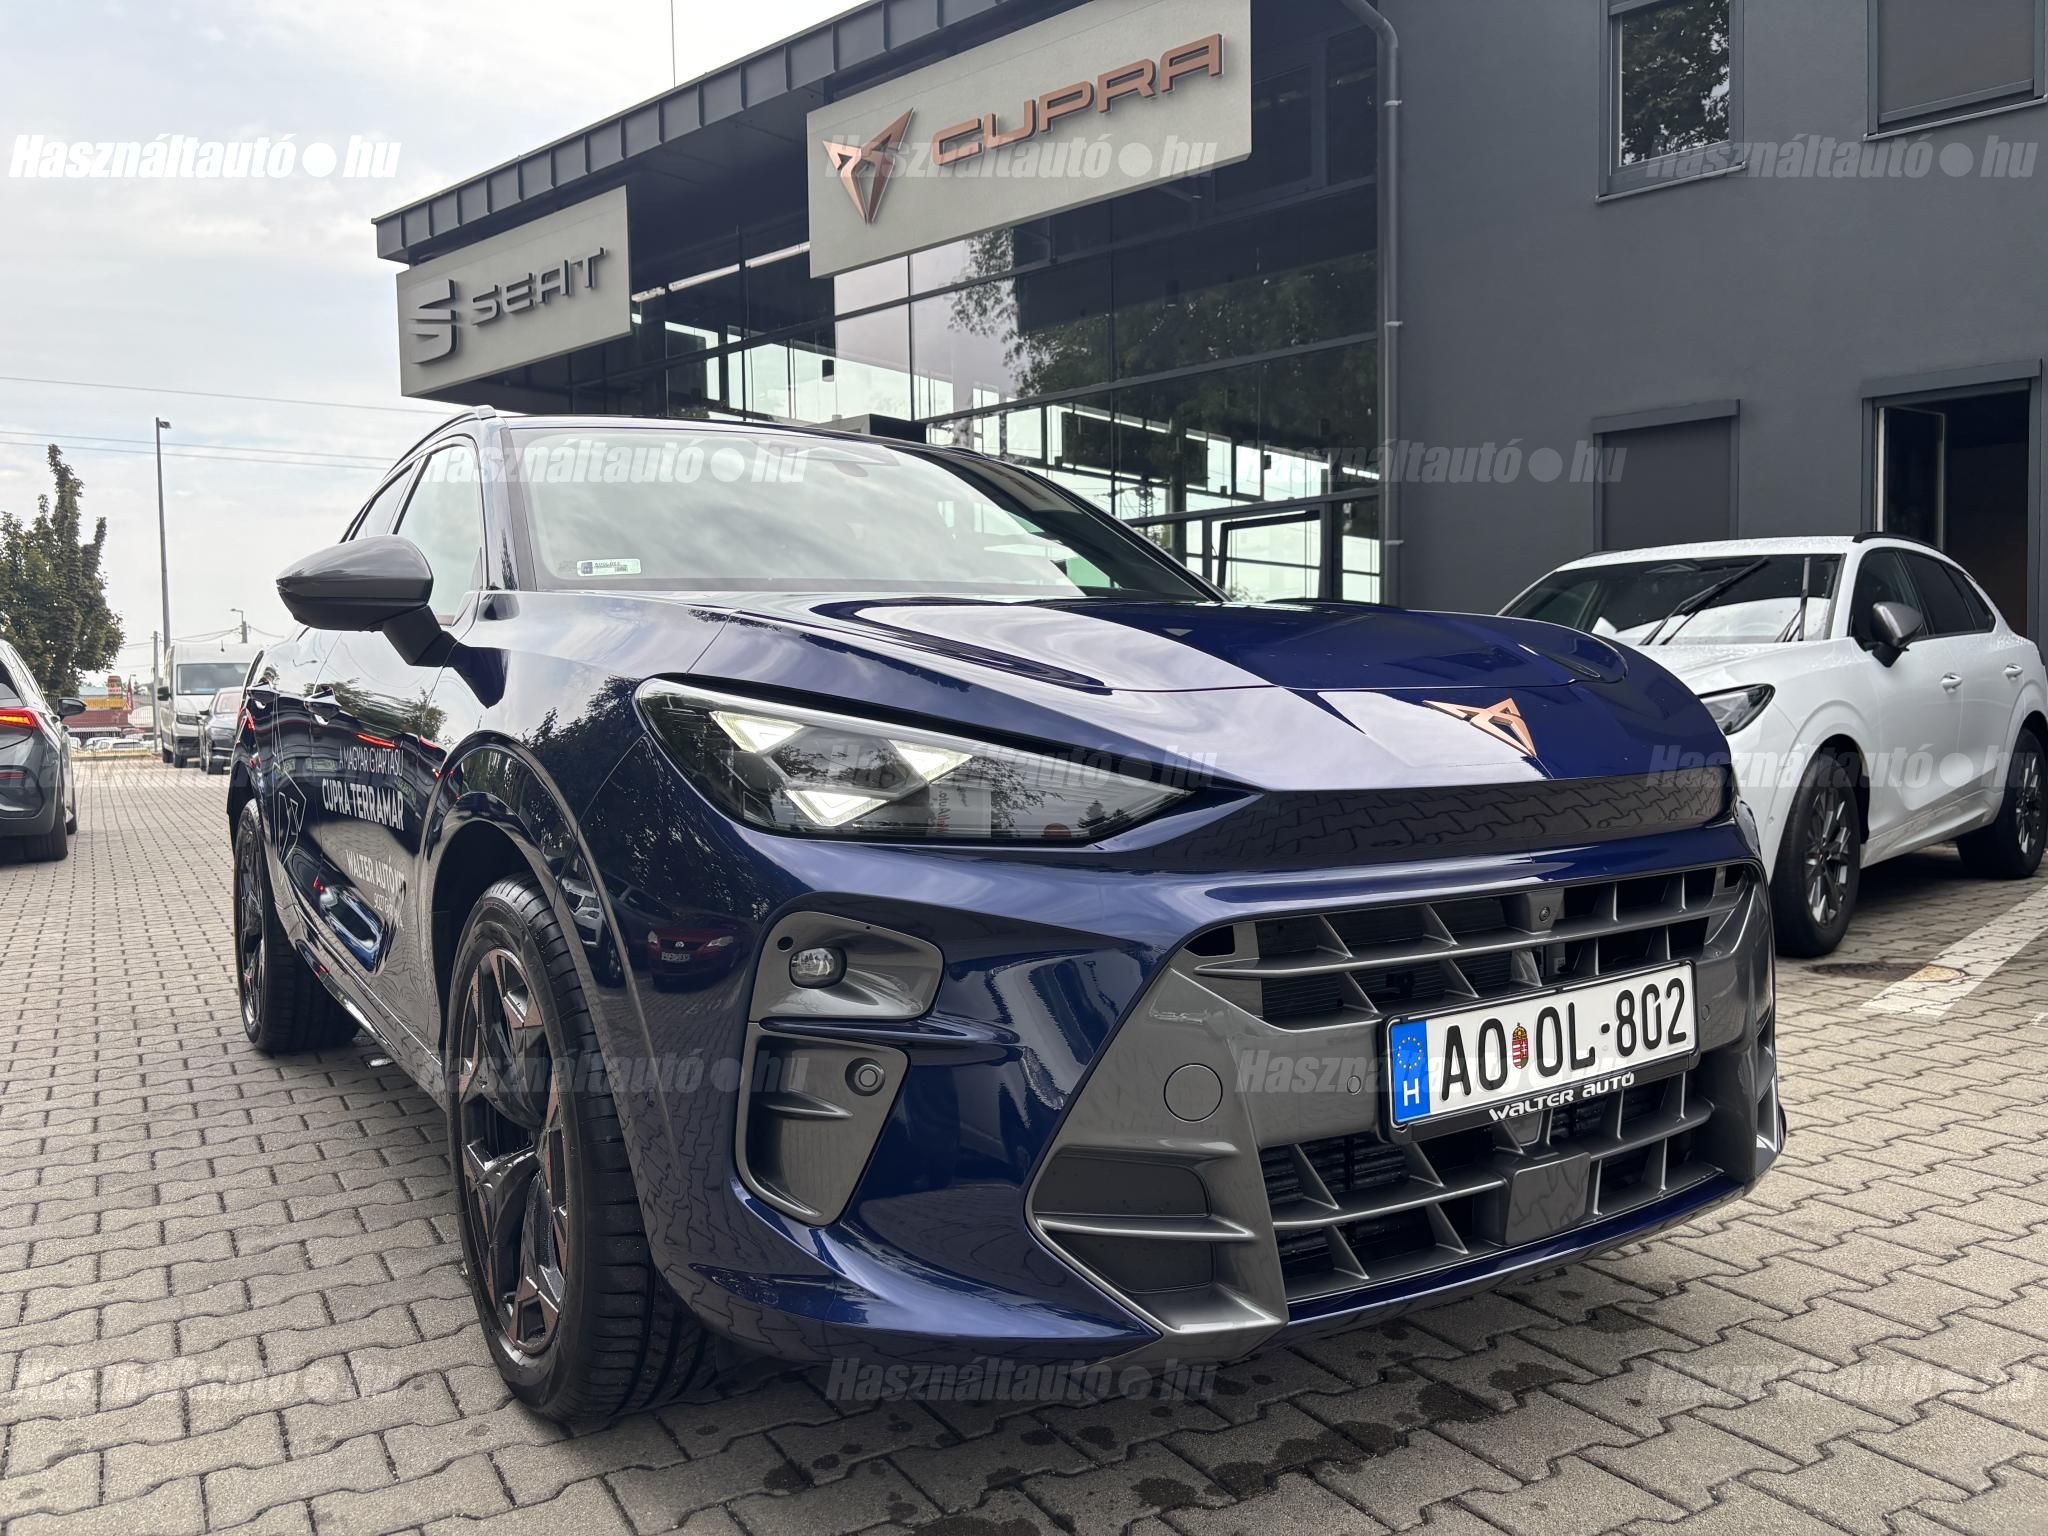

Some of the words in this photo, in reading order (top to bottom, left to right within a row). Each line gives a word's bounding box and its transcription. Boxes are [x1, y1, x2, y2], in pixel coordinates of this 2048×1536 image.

[931, 33, 1224, 166] CUPRA
[471, 247, 606, 327] SEAT
[344, 746, 369, 773] MAGYAR
[322, 778, 352, 816] CUPRA
[350, 783, 404, 831] TERRAMAR
[345, 849, 375, 884] WALTER
[1403, 1077, 1421, 1107] H
[1441, 1017, 1508, 1102] AO
